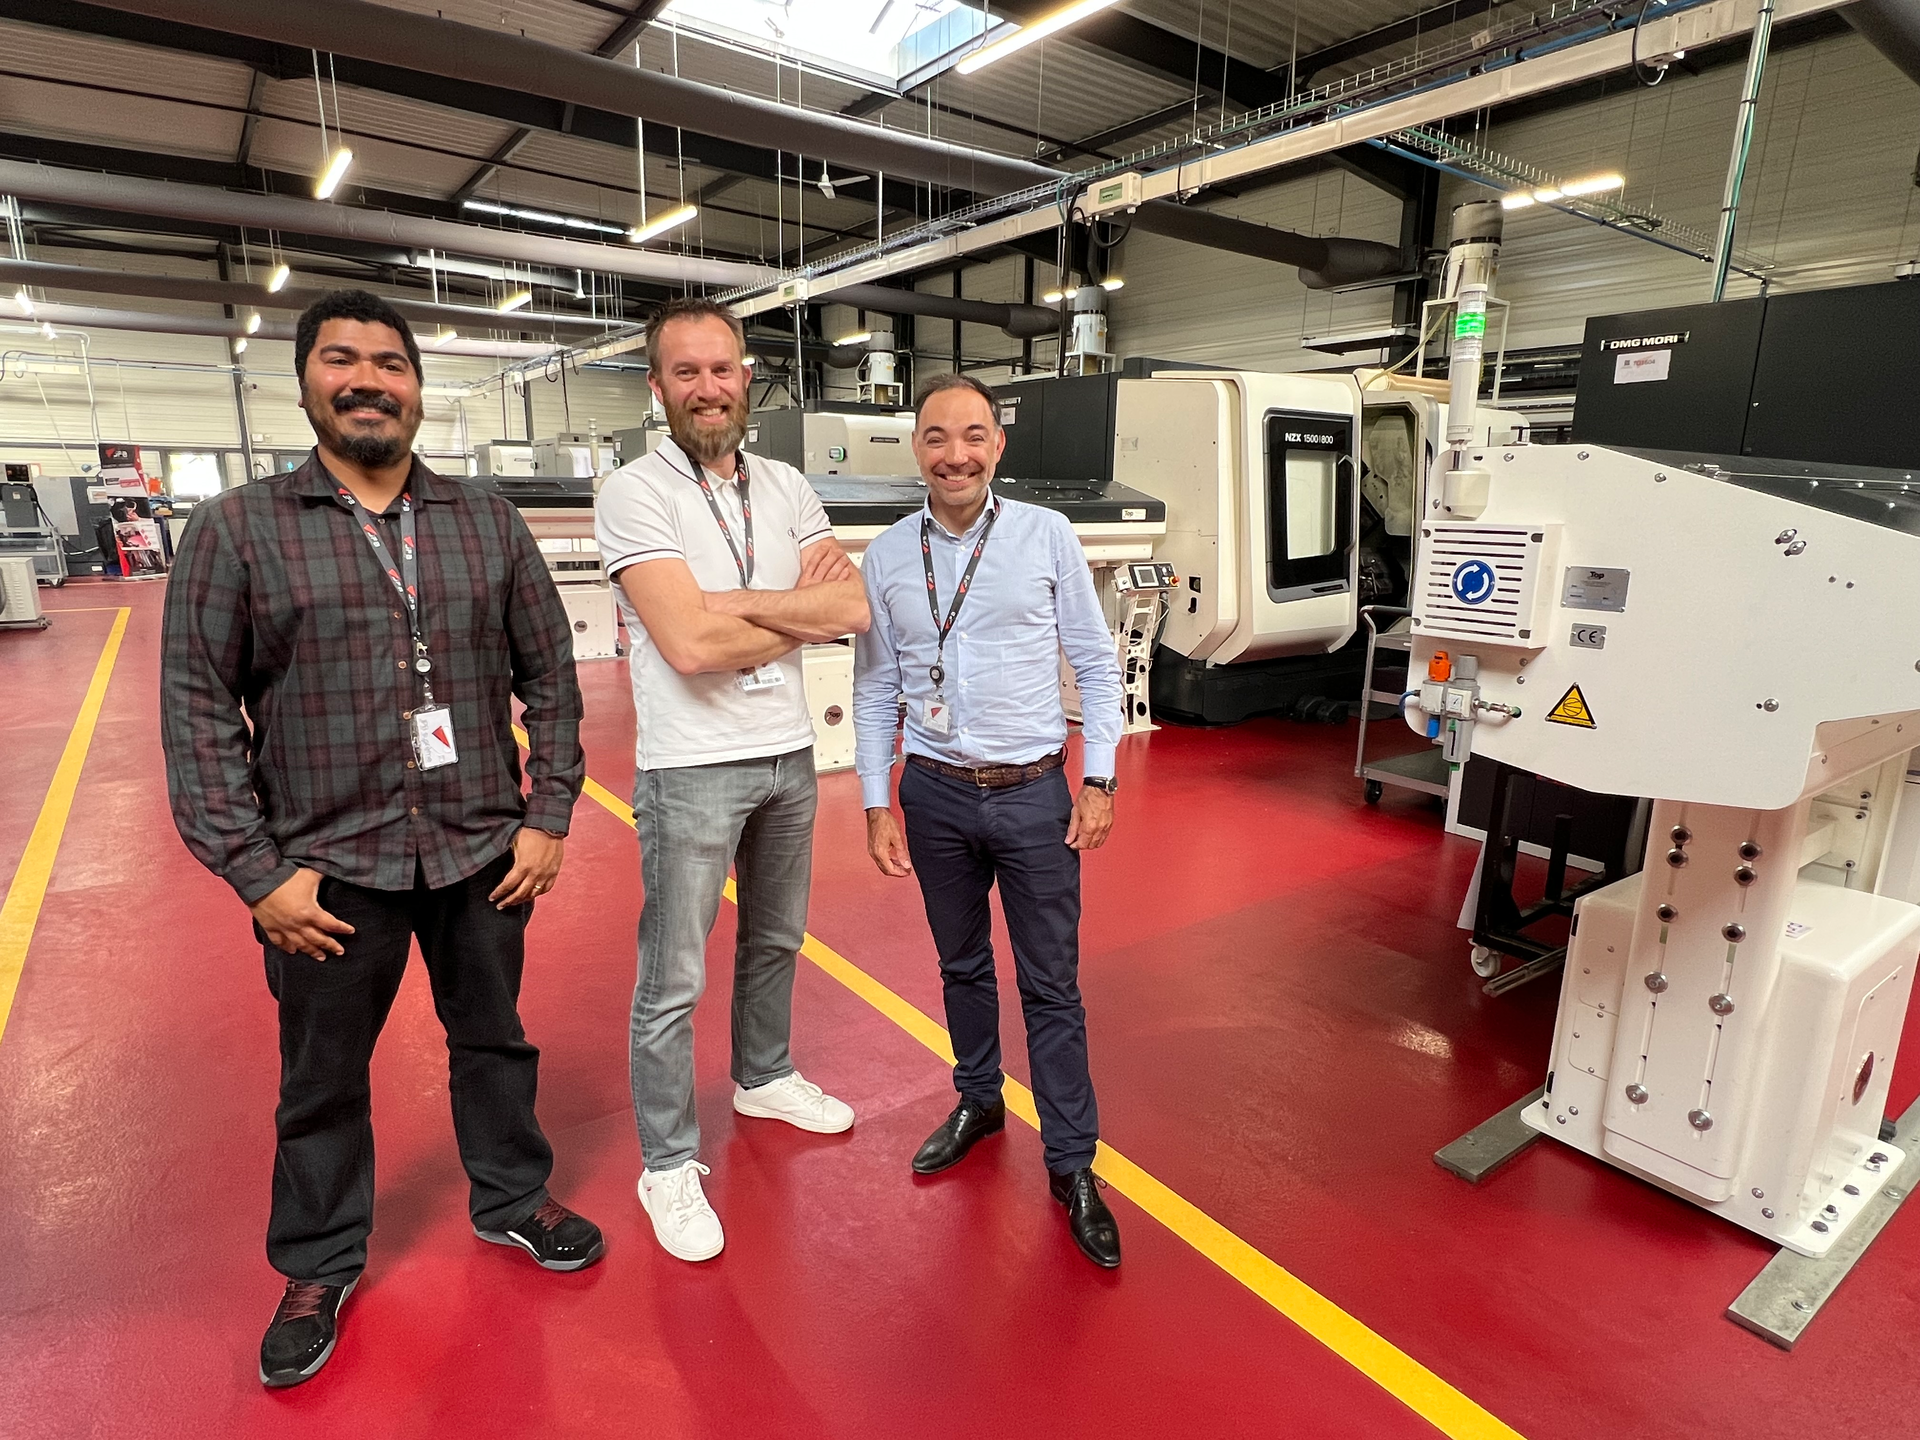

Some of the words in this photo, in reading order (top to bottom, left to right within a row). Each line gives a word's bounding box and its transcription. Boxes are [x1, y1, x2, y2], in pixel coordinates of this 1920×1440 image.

[1610, 338, 1640, 350] DMG
[1642, 335, 1679, 347] MORI
[1285, 432, 1302, 443] NZX
[1590, 571, 1605, 580] Top
[1577, 629, 1598, 644] CE
